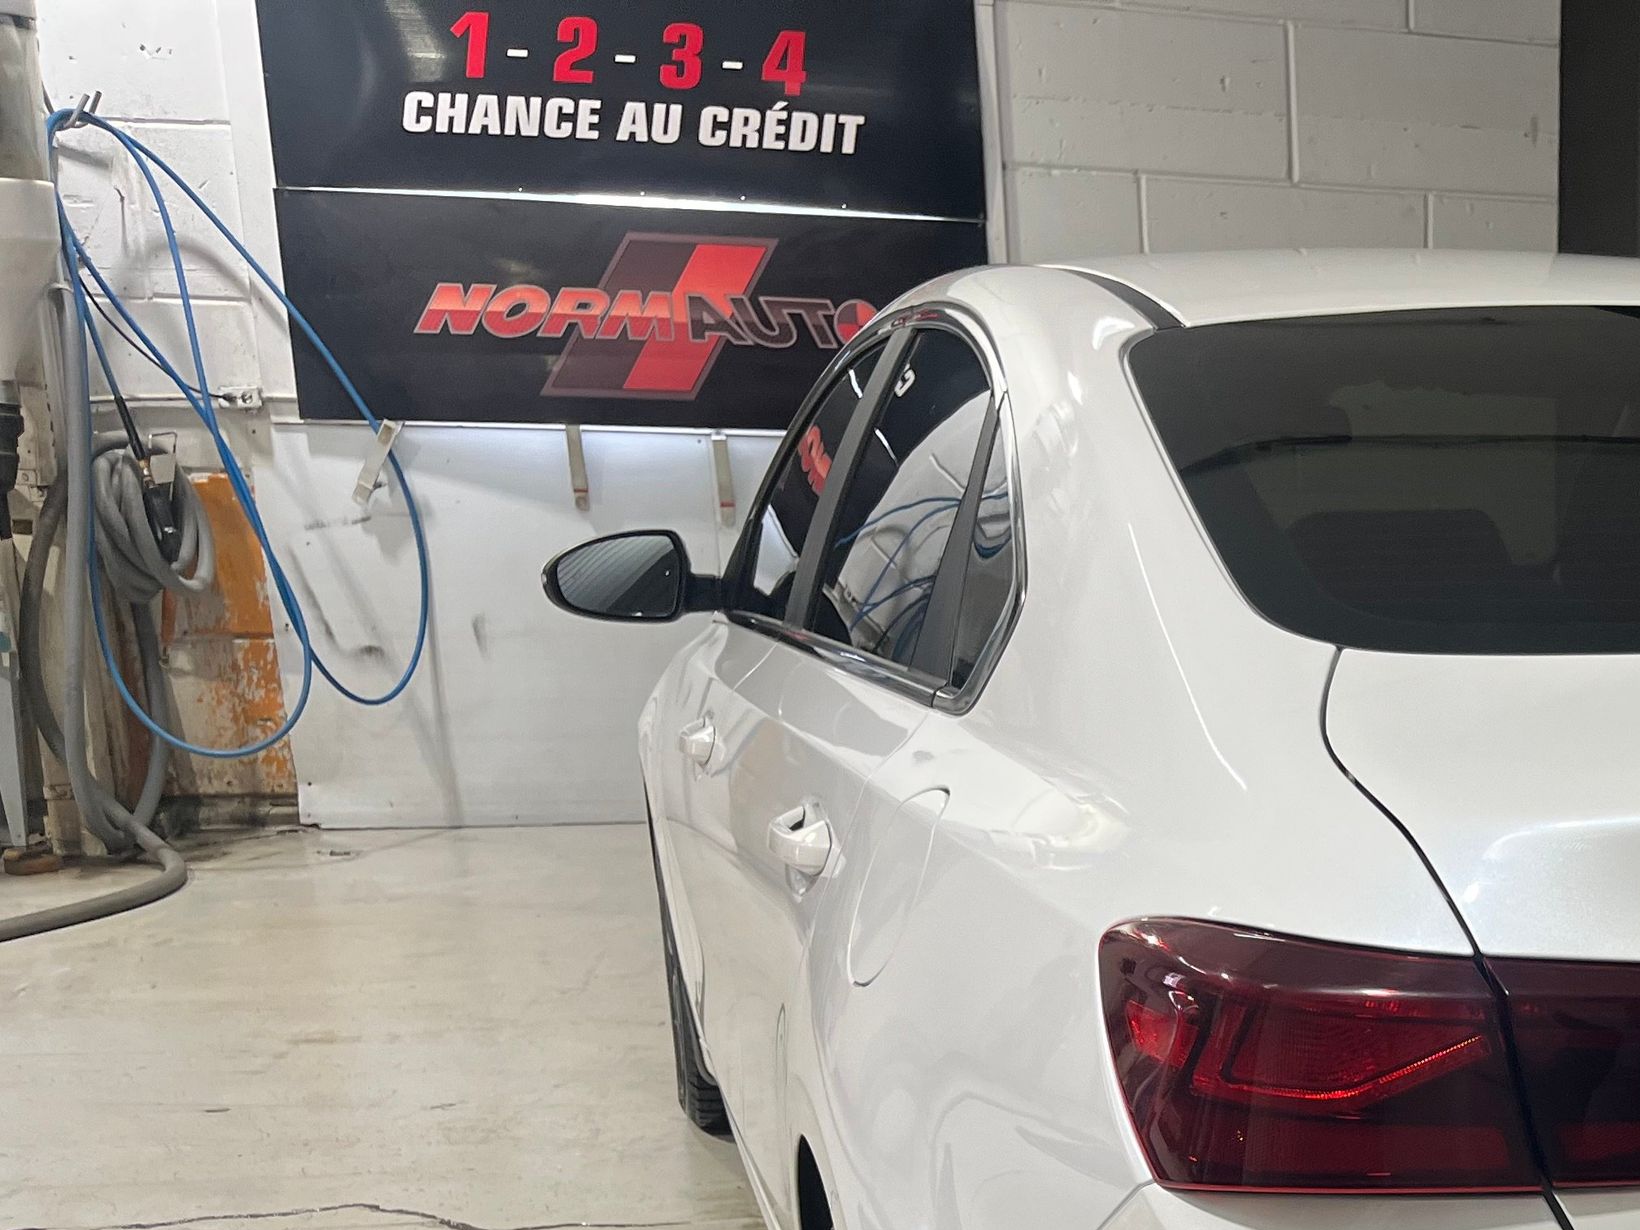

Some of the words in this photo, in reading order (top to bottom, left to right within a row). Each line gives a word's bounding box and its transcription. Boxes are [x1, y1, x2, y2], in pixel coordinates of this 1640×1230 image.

[449, 11, 489, 79] 1
[552, 16, 598, 84] 2
[659, 22, 703, 90] 3
[761, 30, 806, 96] 4
[402, 91, 602, 140] CHANCE
[615, 101, 683, 144] AU
[698, 100, 866, 155] CRÉDIT
